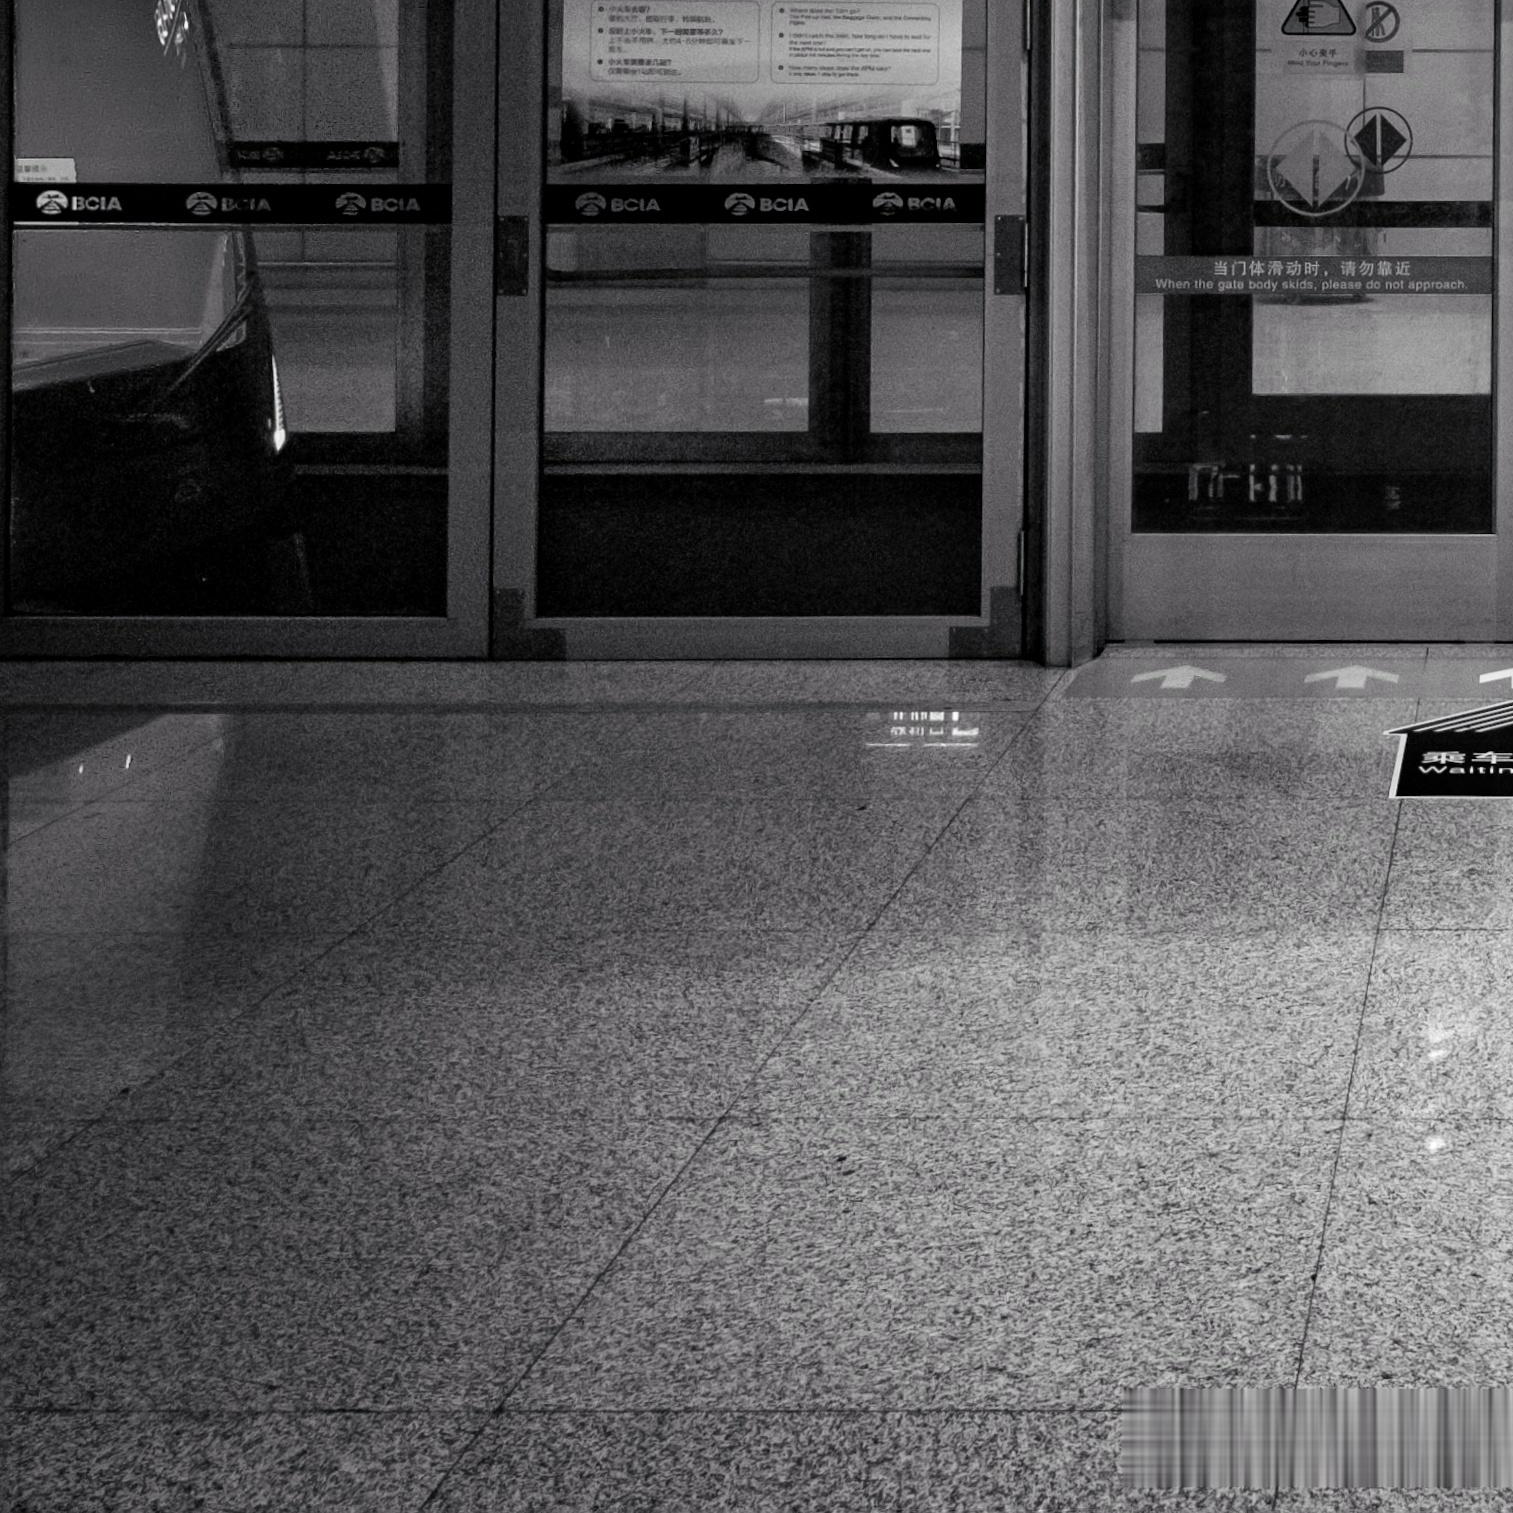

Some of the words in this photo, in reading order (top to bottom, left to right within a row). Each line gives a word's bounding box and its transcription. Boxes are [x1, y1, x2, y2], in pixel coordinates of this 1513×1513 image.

[71, 196, 122, 212] BCIA
[370, 197, 421, 212] BCIA
[610, 197, 661, 213] BCIA
[759, 197, 810, 212] BCIA
[1155, 278, 1191, 289] When
[1194, 278, 1214, 289] the
[1217, 280, 1244, 292] gate
[1248, 278, 1278, 292] body
[1321, 278, 1362, 292] please
[1365, 278, 1381, 290] do
[1385, 279, 1404, 290] not
